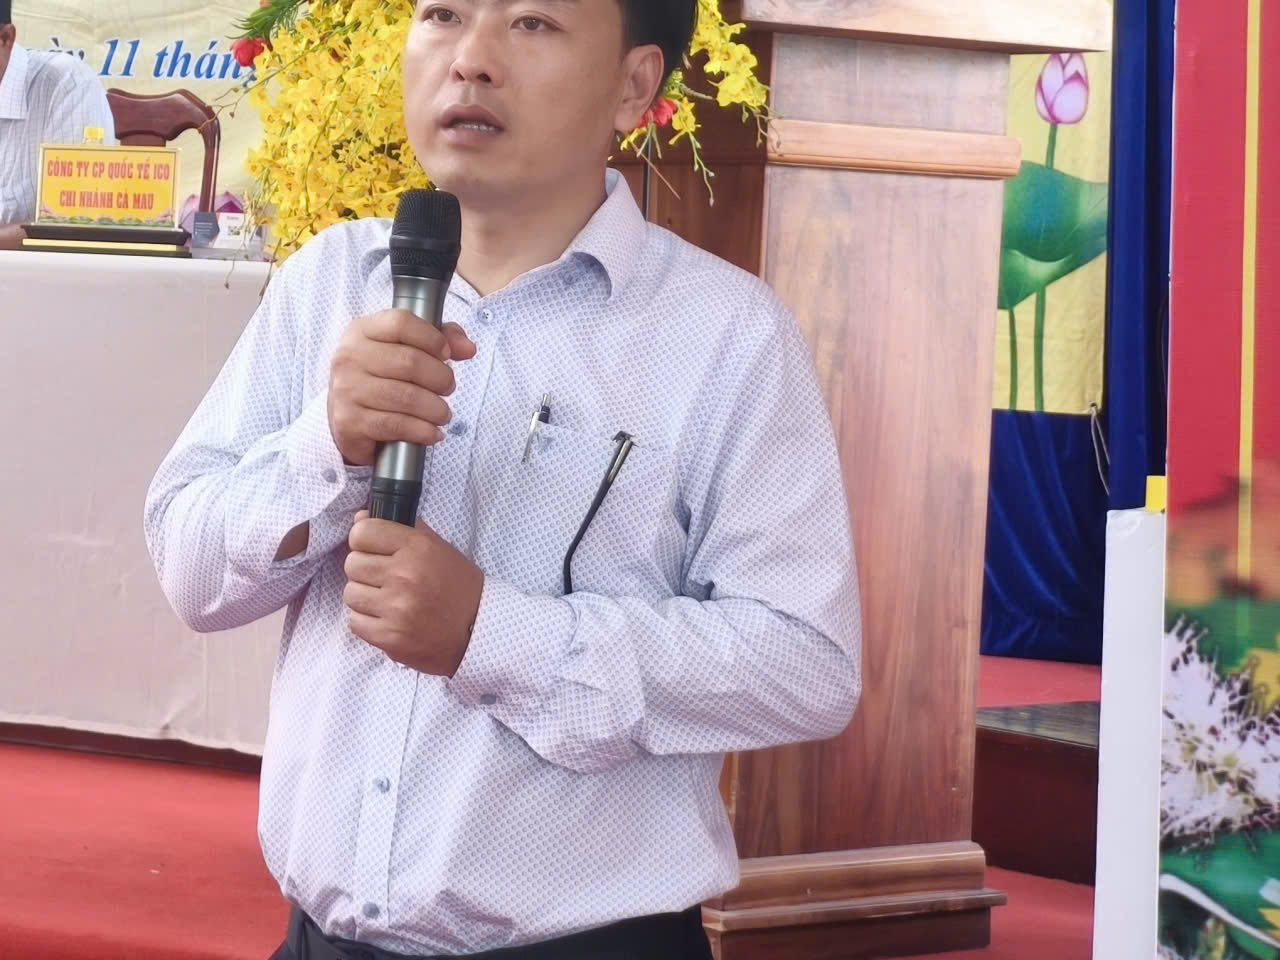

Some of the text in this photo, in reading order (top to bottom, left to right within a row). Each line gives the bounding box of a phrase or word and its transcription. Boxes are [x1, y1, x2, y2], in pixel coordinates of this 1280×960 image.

[98, 39, 140, 76] 11
[153, 40, 257, 87] thán
[47, 156, 73, 177] CÔNG
[76, 161, 90, 178] TY
[92, 161, 105, 178] CP
[108, 156, 134, 180] QUỐC
[137, 156, 151, 179] TẾ
[60, 190, 76, 207] CHI
[116, 188, 129, 209] CÀ
[132, 193, 154, 210] MAU
